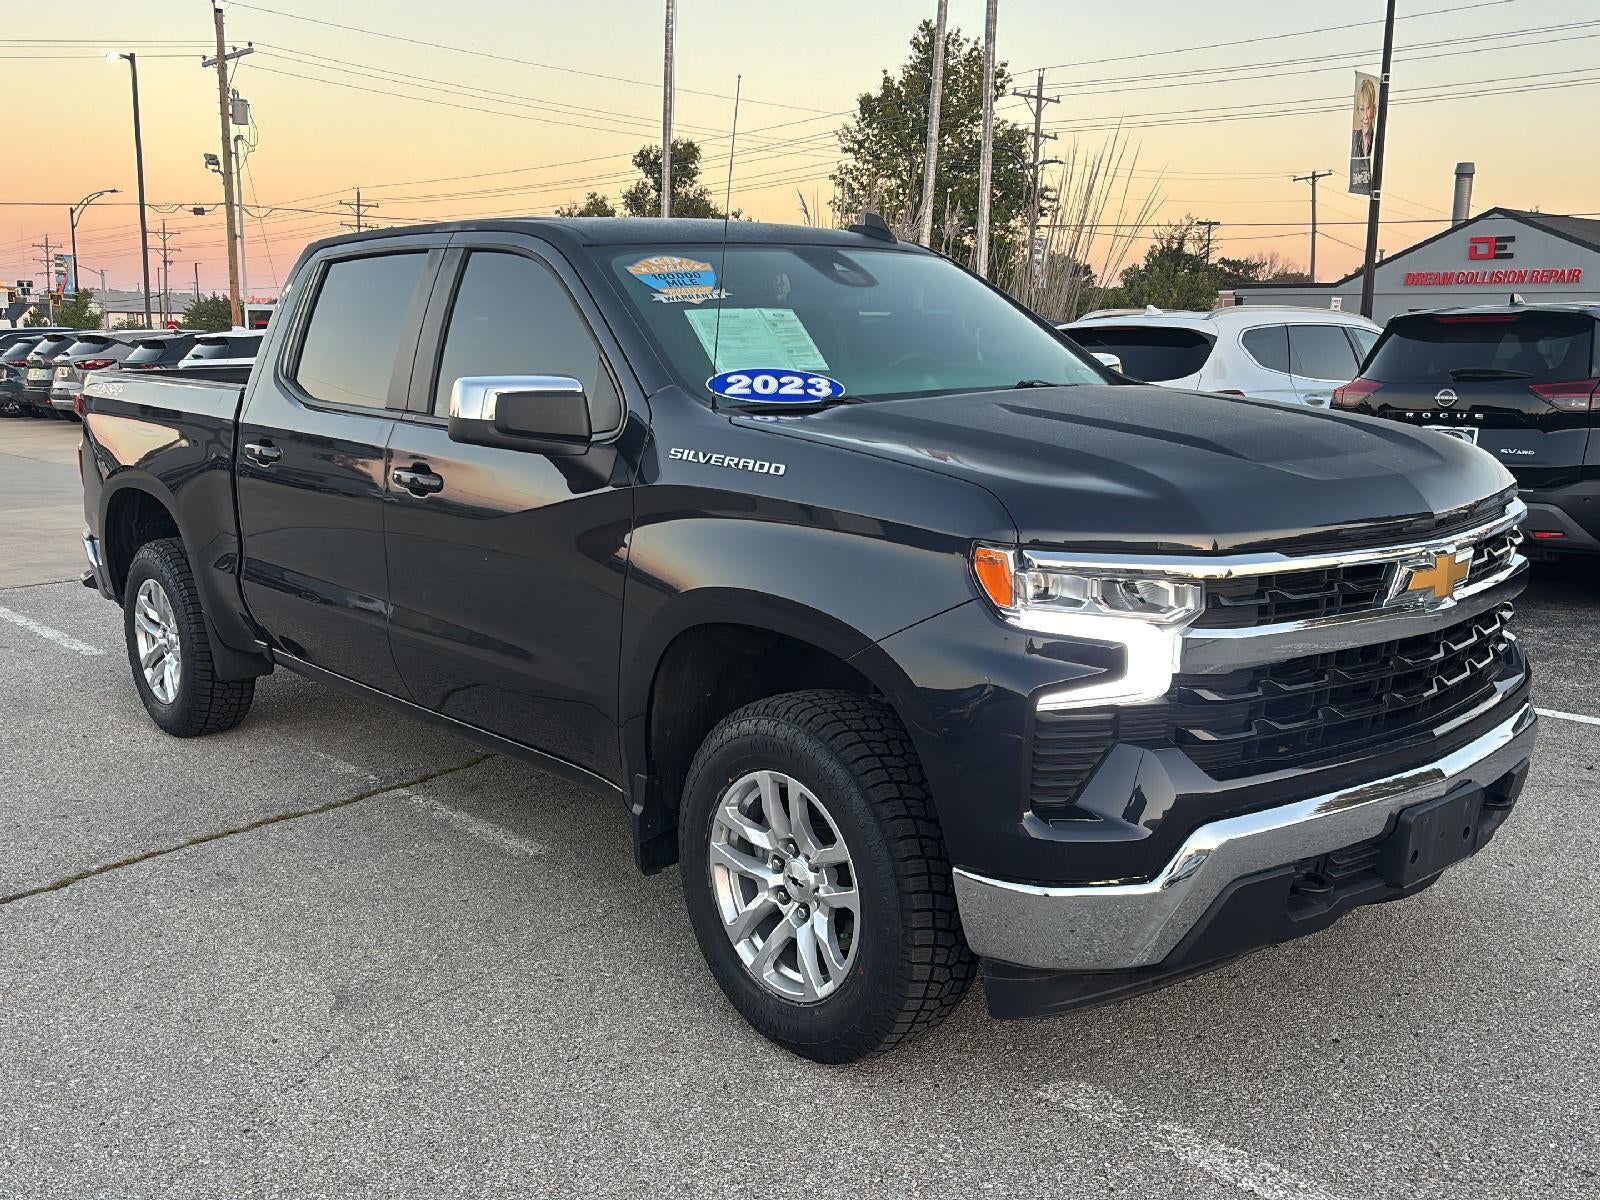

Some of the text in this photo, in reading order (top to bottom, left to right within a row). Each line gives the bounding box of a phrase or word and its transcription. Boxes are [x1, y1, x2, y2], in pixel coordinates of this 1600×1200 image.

[665, 279, 701, 288] MILE
[1403, 267, 1583, 286] DREAM COLLISION REPAIR
[664, 291, 722, 302] WARRANTY
[724, 375, 833, 397] 2023
[1405, 412, 1483, 420] ROGUE
[668, 447, 786, 476] SILVERADO
